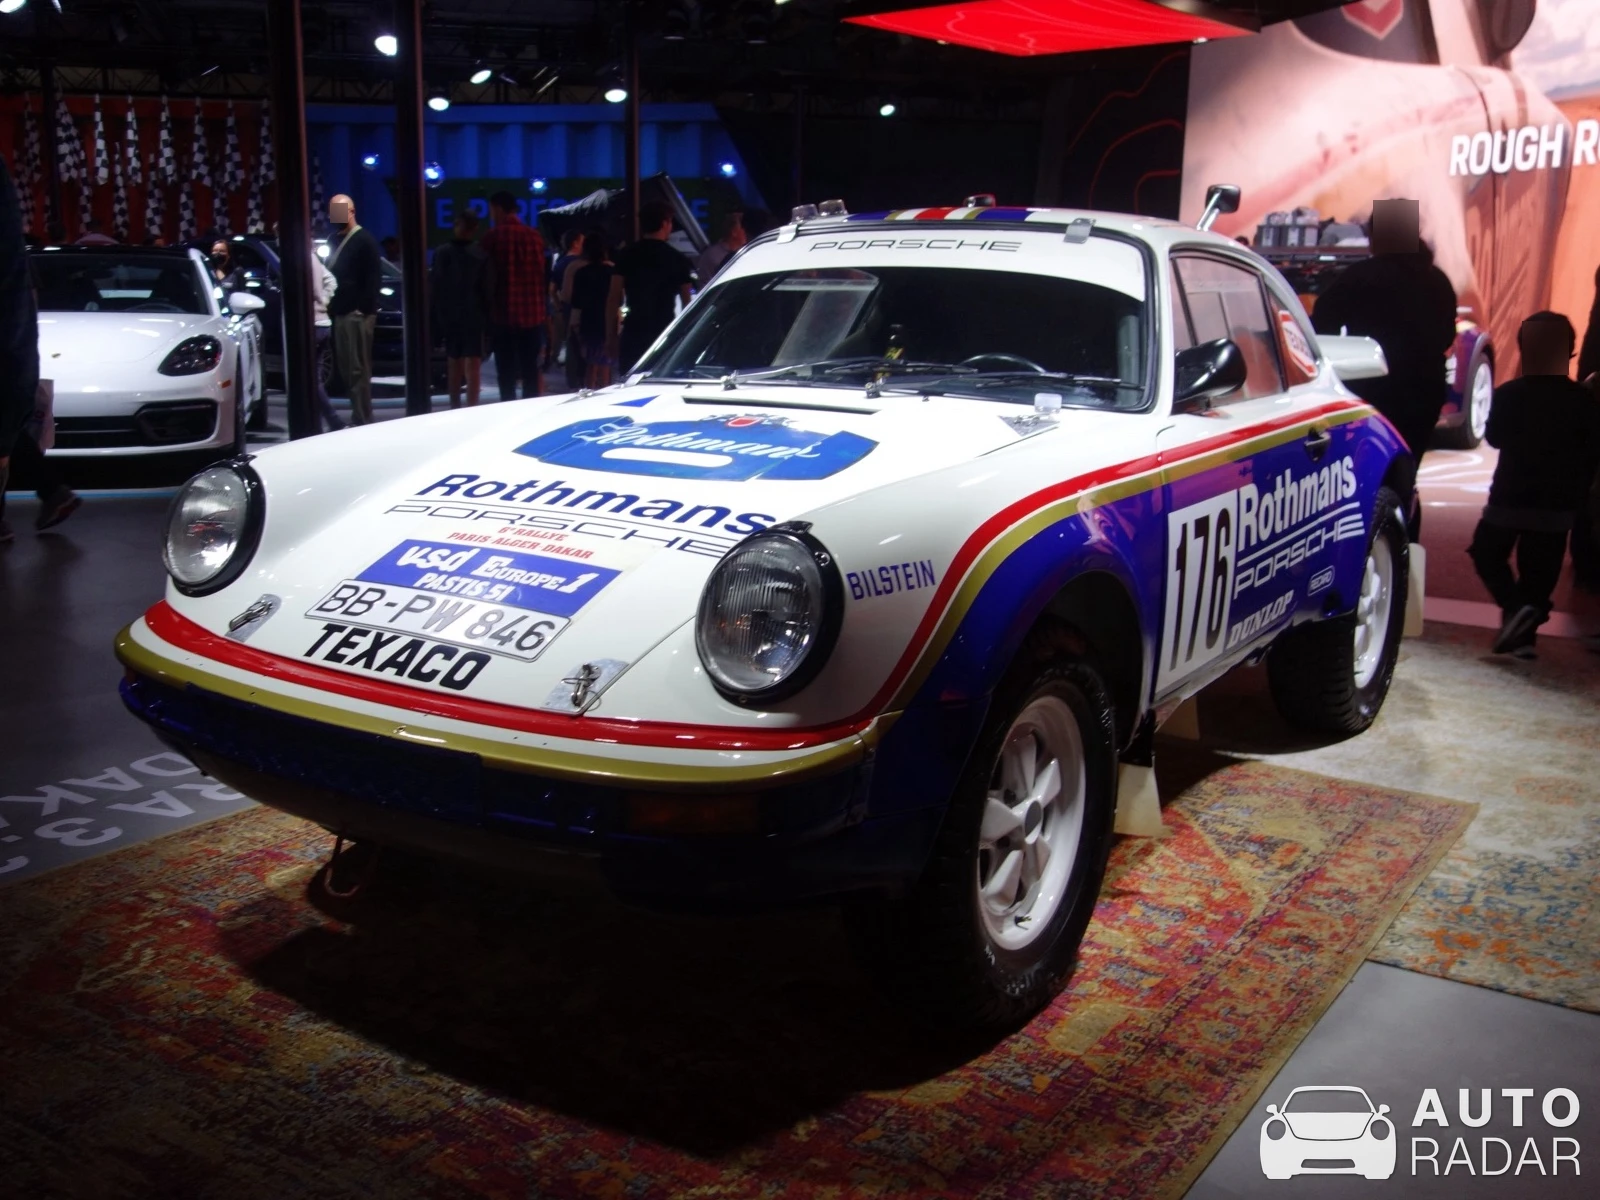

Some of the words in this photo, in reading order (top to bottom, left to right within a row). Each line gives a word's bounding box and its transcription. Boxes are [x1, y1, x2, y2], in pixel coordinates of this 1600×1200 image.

[1449, 123, 1564, 176] ROUGH
[1573, 119, 1600, 167] R
[809, 239, 1023, 253] PORSCHE
[572, 422, 822, 460] Rothmans
[383, 504, 731, 559] PORSCHE
[415, 473, 777, 536] Rothmans
[1237, 455, 1357, 553] Rothmans
[515, 528, 569, 542] RALLYE
[1233, 513, 1365, 600] PORSCHE
[413, 573, 492, 597] PASTIS
[483, 583, 516, 601] 51
[846, 559, 936, 601] BILSTEIN
[1169, 507, 1231, 672] 176
[315, 584, 475, 633] BB-PW
[464, 609, 556, 651] 846
[1225, 589, 1294, 650] DUNLOP
[303, 623, 492, 691] TEXACO
